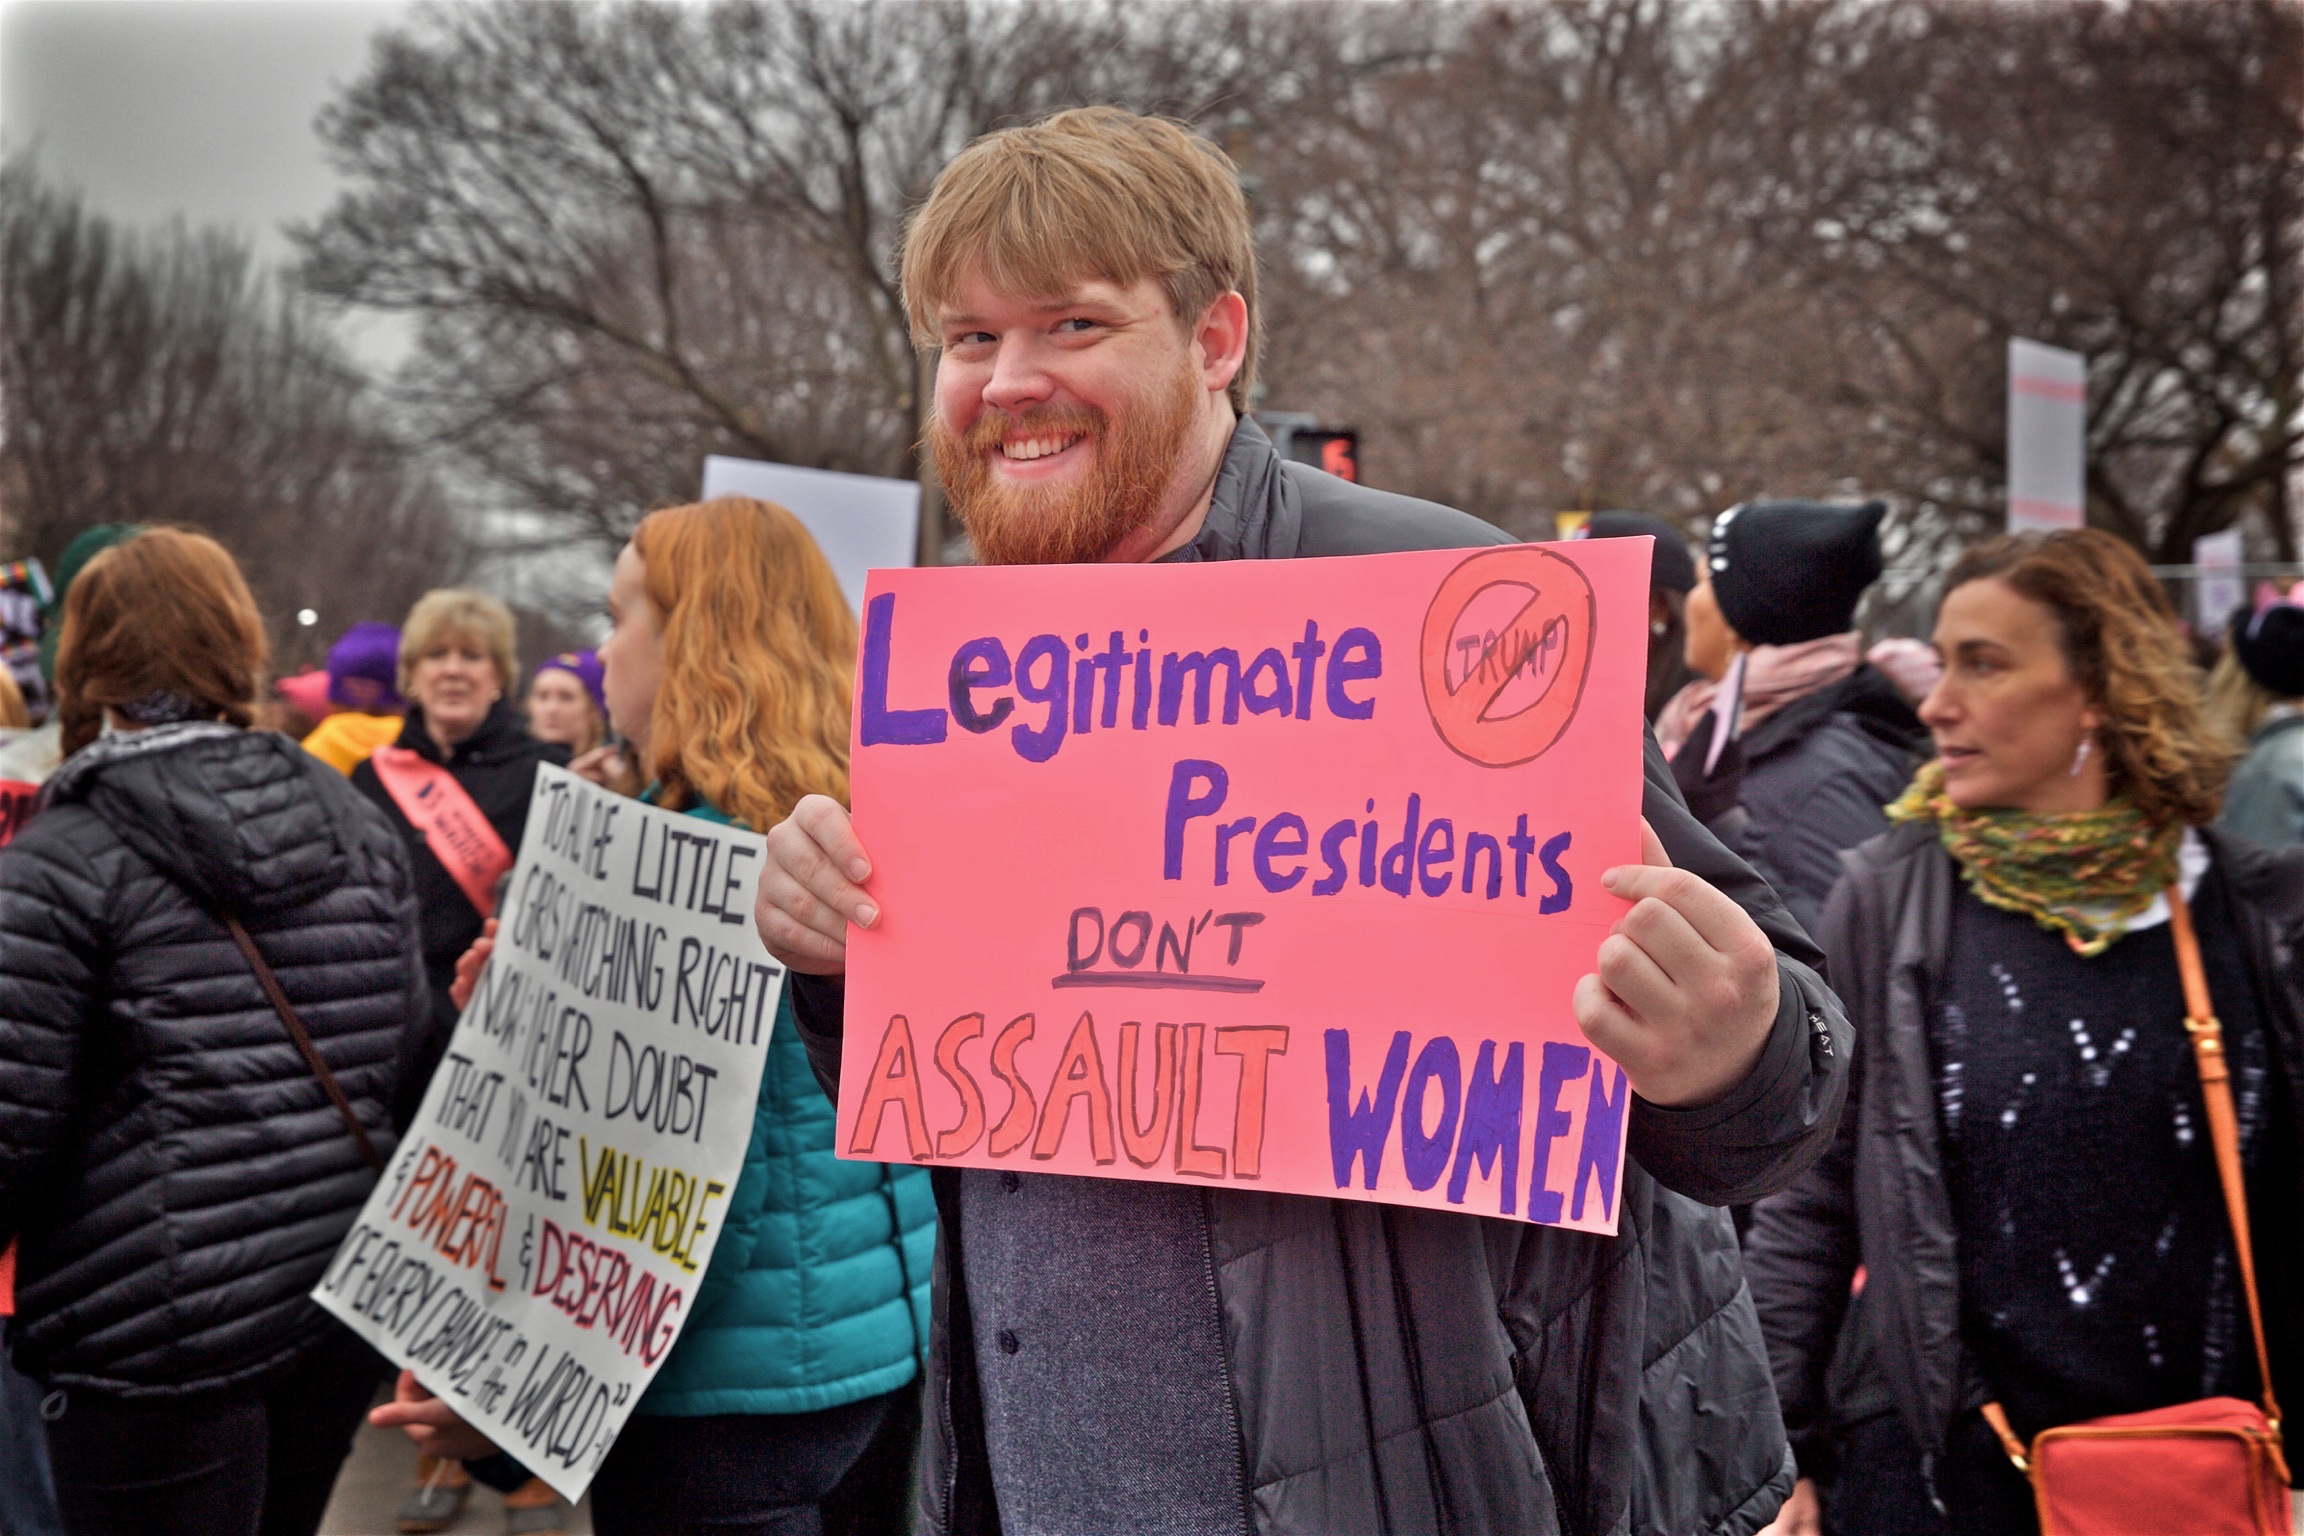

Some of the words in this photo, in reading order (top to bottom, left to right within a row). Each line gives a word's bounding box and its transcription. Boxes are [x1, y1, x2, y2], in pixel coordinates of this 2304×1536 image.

[861, 592, 1382, 763] Legitimate
[1456, 617, 1558, 685] TRUMP
[632, 814, 757, 925] LITTLE
[1163, 759, 1572, 915] Presidents
[672, 936, 781, 1046] RIGHT
[1066, 906, 1266, 974] DON'T
[606, 1030, 718, 1143] DOUBT
[1808, 1013, 1835, 1057] HEAT
[848, 1010, 1290, 1180] ASSAULT
[1323, 1027, 1628, 1224] WOMEN
[436, 1052, 505, 1143] THAT
[514, 1117, 571, 1201] ARE
[579, 1134, 726, 1272] VALUABLE
[352, 1240, 446, 1340] EVERY
[531, 1218, 682, 1370] DESERVING
